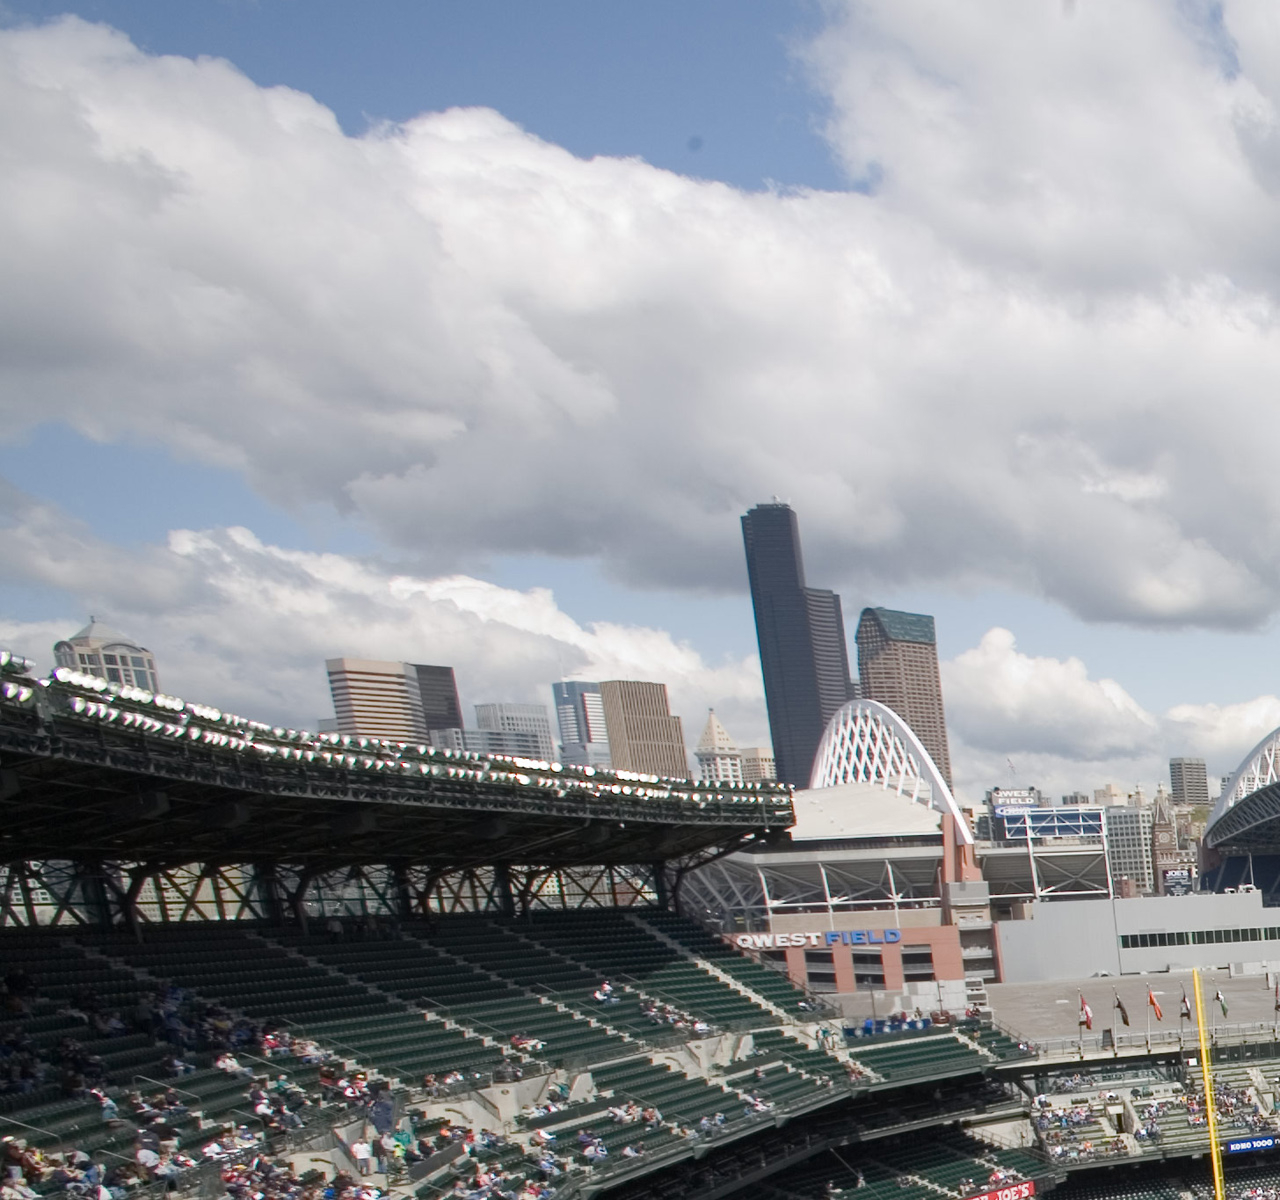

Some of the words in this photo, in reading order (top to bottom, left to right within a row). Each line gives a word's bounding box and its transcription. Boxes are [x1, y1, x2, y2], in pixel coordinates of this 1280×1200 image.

[998, 797, 1035, 805] FIELD
[736, 931, 822, 950] QWEST
[824, 928, 902, 947] FIELD
[1253, 1139, 1273, 1149] 1000
